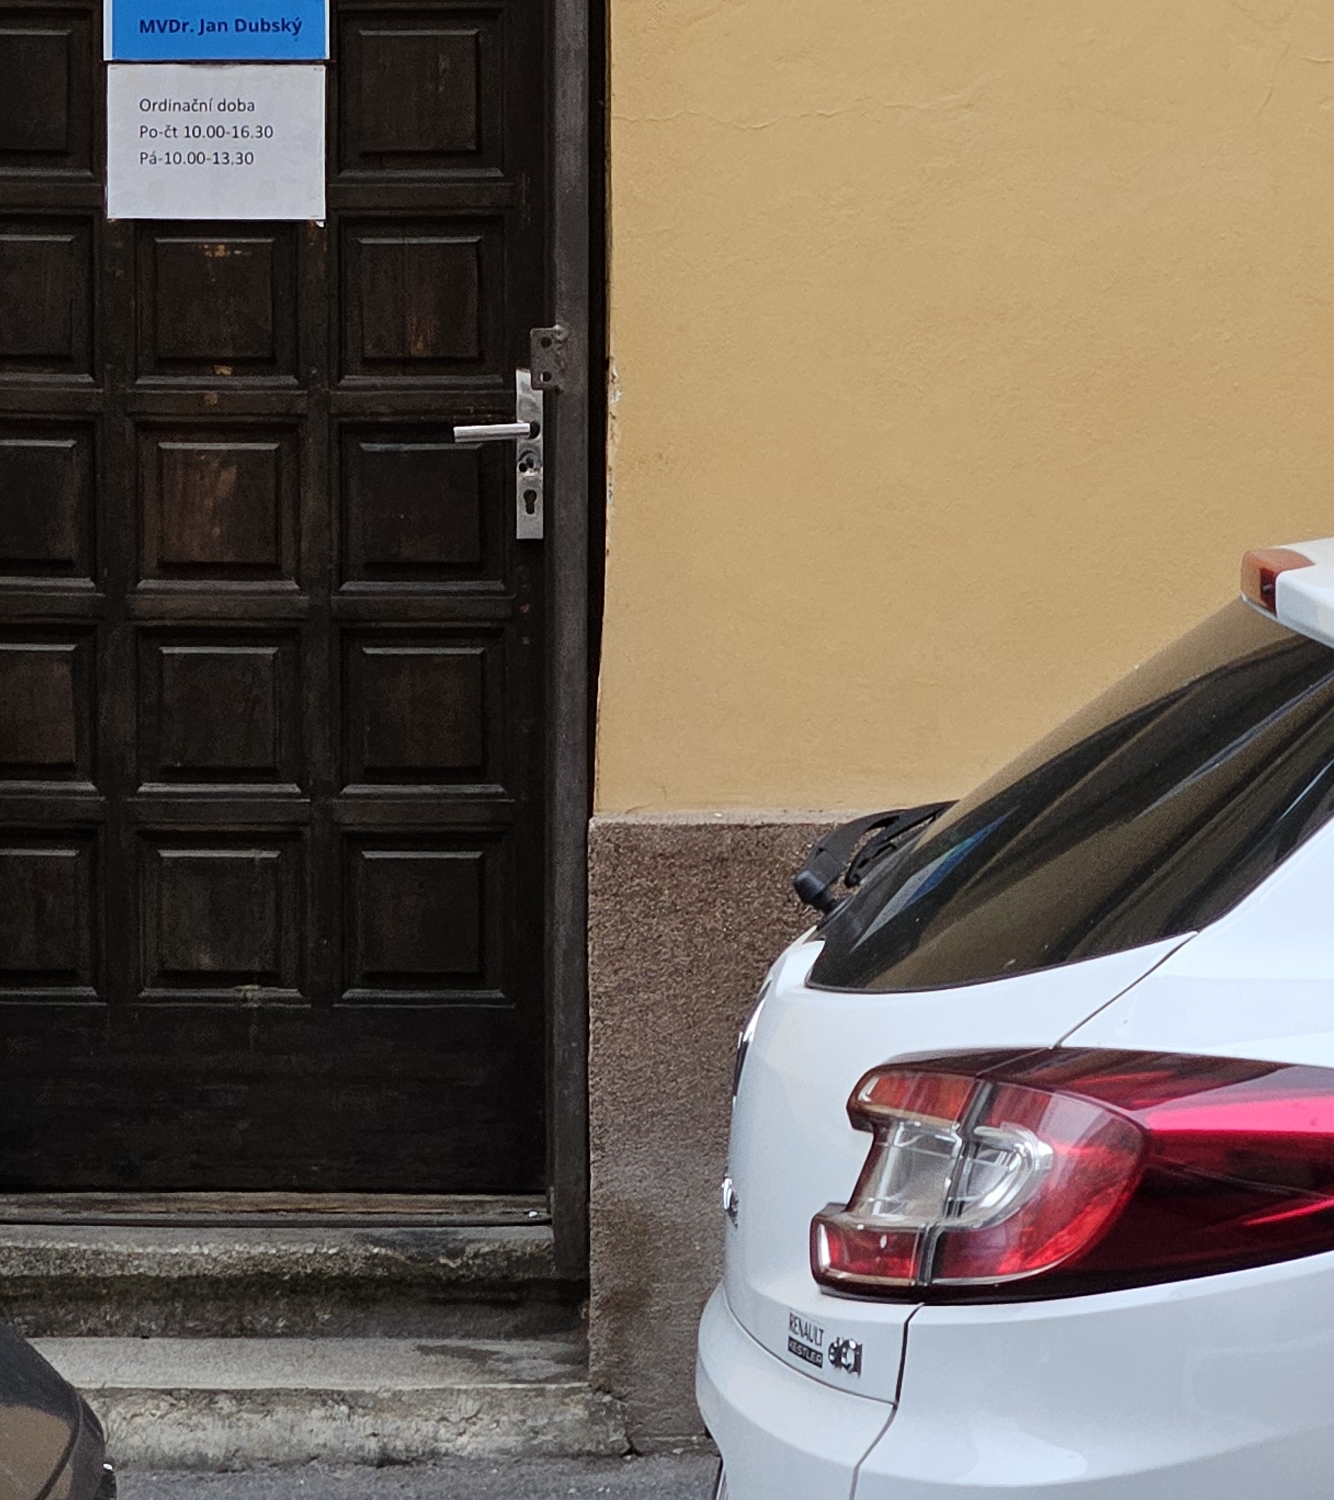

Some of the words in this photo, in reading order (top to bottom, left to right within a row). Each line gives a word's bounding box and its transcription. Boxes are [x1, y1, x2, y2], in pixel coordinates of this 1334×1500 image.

[139, 19, 195, 34] MVDr.
[198, 19, 228, 36] Jan
[235, 17, 303, 36] Dubský
[139, 98, 213, 113] Ordinační
[217, 98, 255, 113] doba
[139, 125, 178, 140] Po-čt
[184, 125, 274, 139] 10.00-16.30
[139, 151, 255, 166] Pá-10.00-13.30
[788, 1311, 825, 1348] RENAULT
